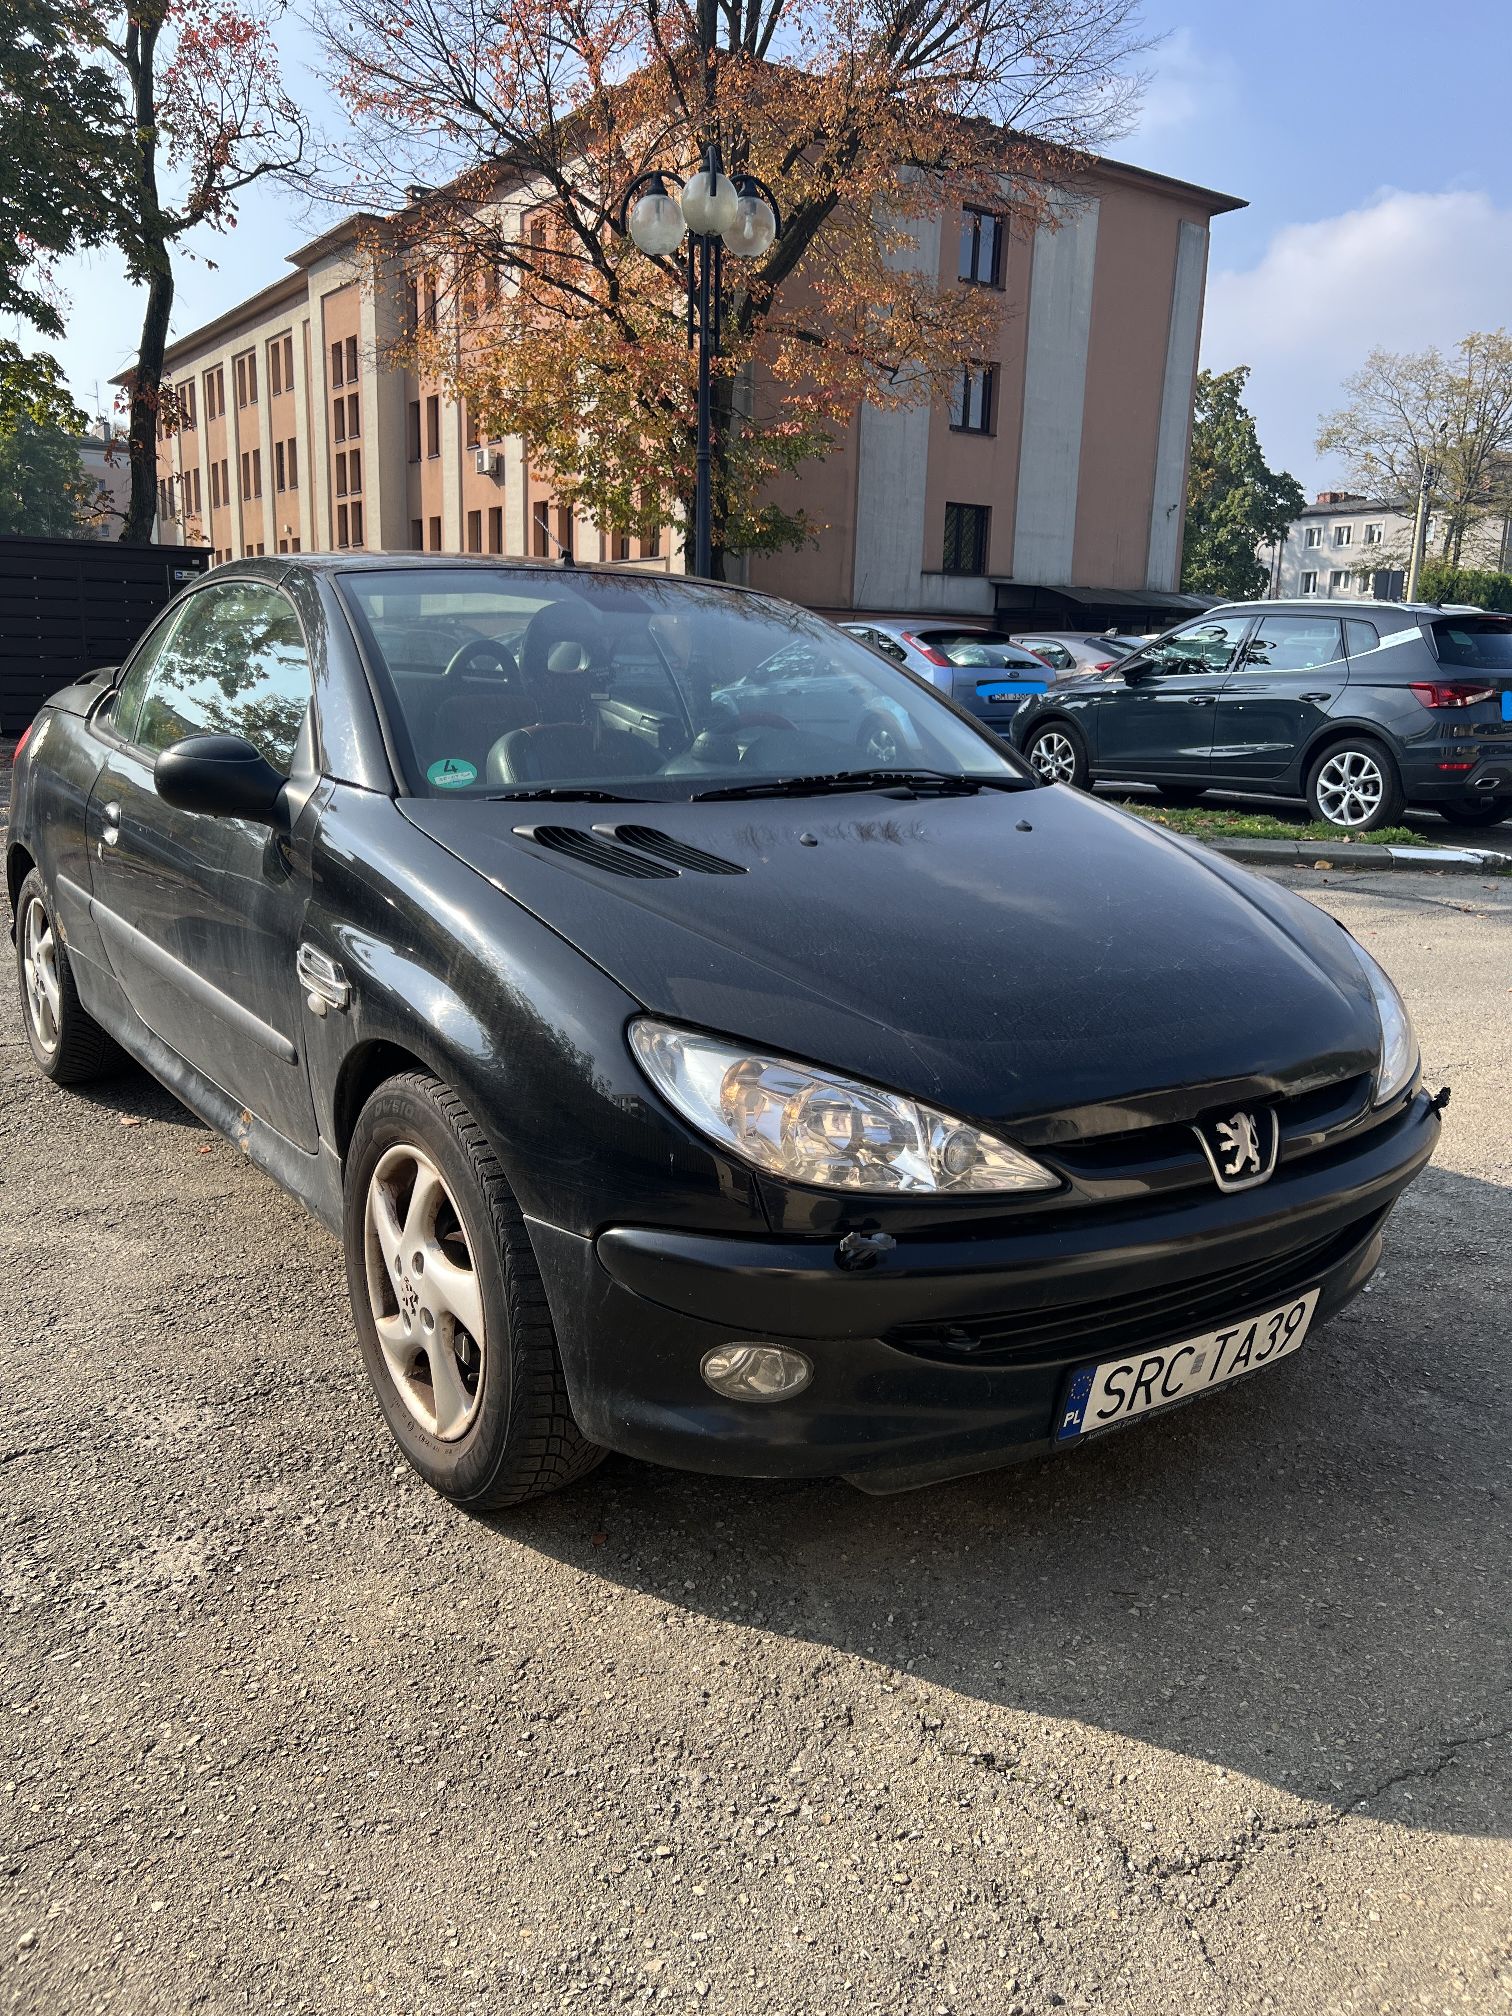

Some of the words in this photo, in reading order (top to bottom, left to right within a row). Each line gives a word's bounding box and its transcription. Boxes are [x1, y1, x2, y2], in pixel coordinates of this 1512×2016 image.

[444, 760, 458, 773] 4
[1096, 1346, 1195, 1419] SRC
[1208, 1301, 1306, 1381] TA39
[1063, 1411, 1081, 1428] PL
